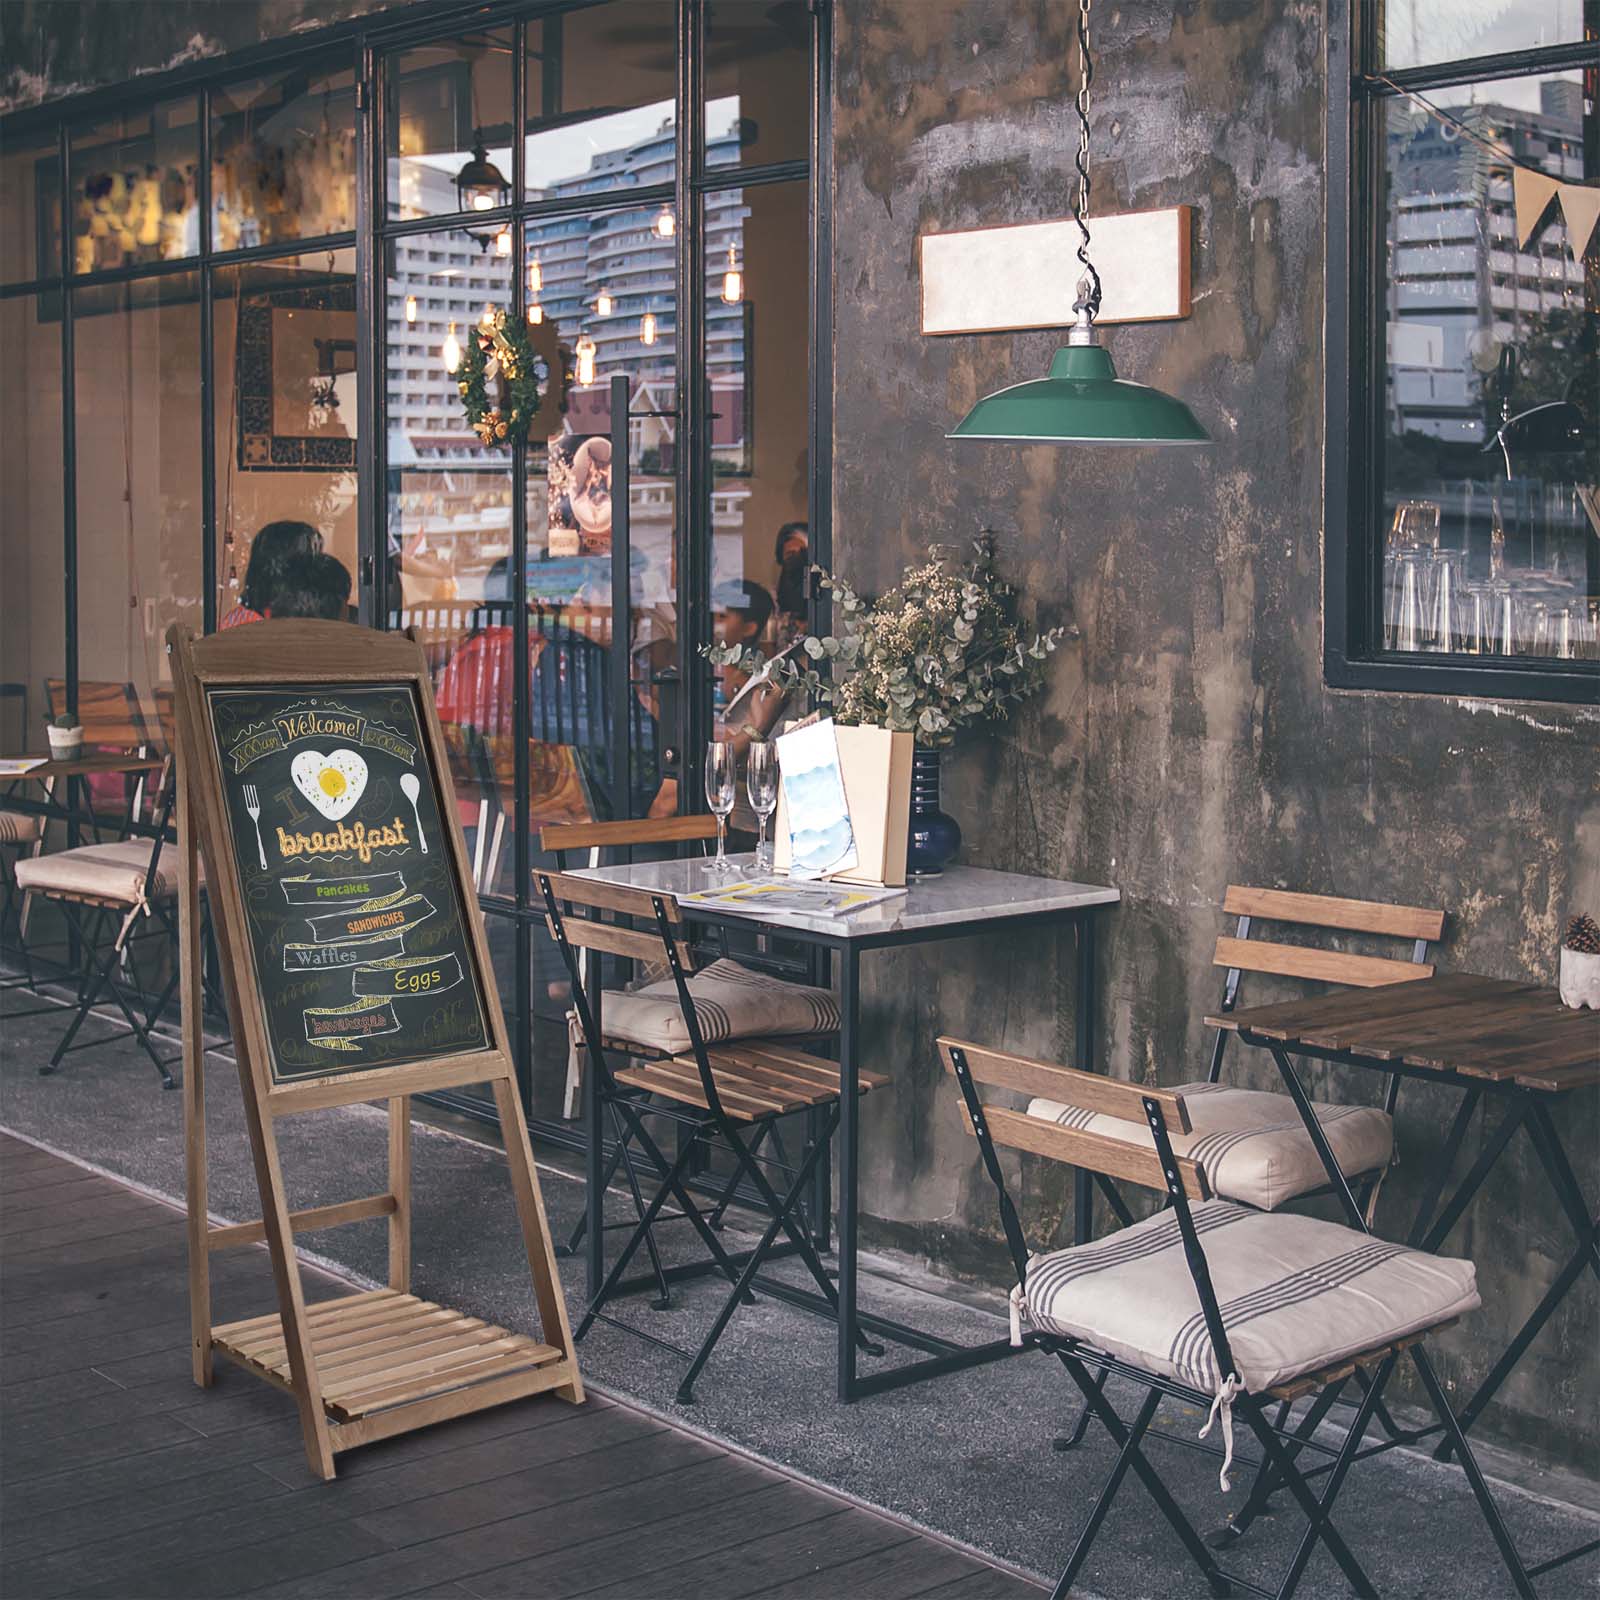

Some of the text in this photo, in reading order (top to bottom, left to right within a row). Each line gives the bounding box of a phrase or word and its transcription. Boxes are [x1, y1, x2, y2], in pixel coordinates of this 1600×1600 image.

[278, 711, 360, 741] Welcome!
[276, 817, 409, 863] breakfast
[346, 910, 405, 934] SANDWICHES
[295, 947, 358, 965] Waffles
[393, 969, 442, 993] Eggs
